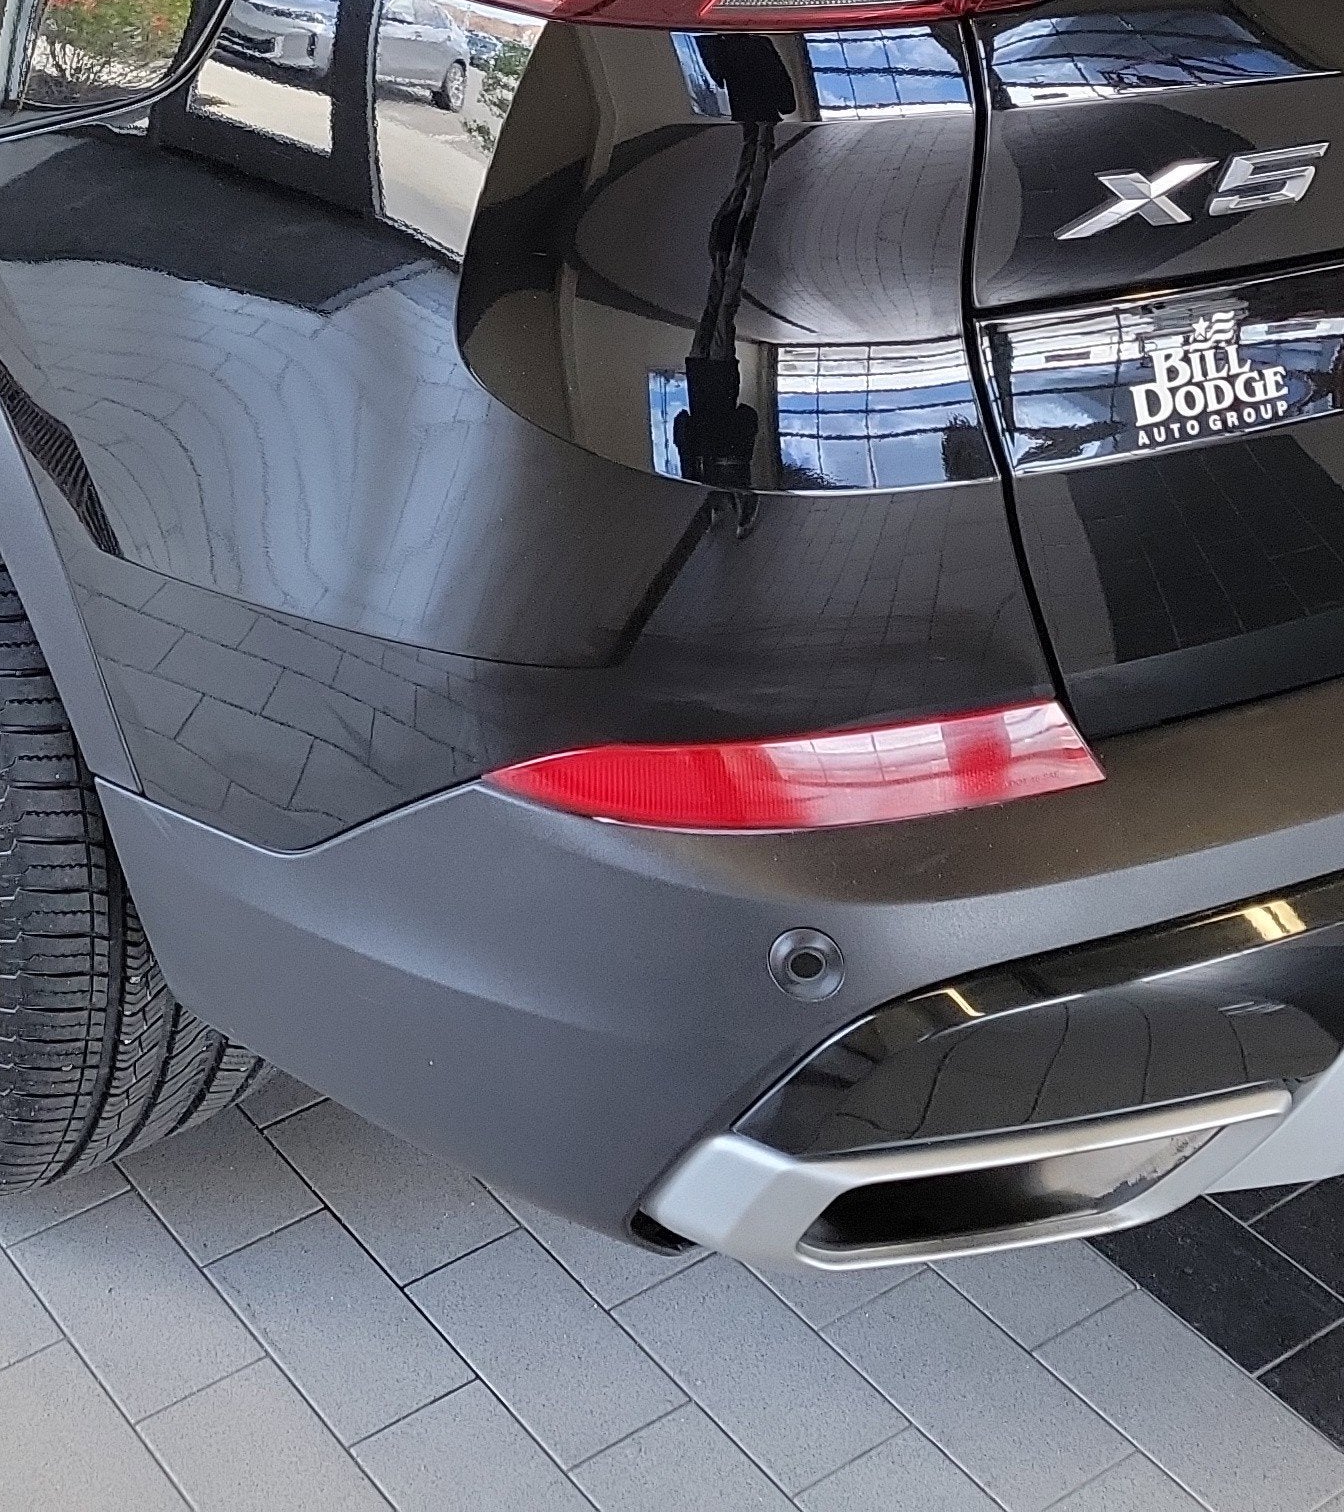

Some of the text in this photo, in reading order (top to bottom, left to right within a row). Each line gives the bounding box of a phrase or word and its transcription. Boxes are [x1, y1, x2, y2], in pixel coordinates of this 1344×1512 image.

[1056, 141, 1331, 240] X5
[1150, 344, 1252, 389] BILL
[1129, 366, 1289, 427] DODGE
[1138, 400, 1288, 446] AUTO GROUP
